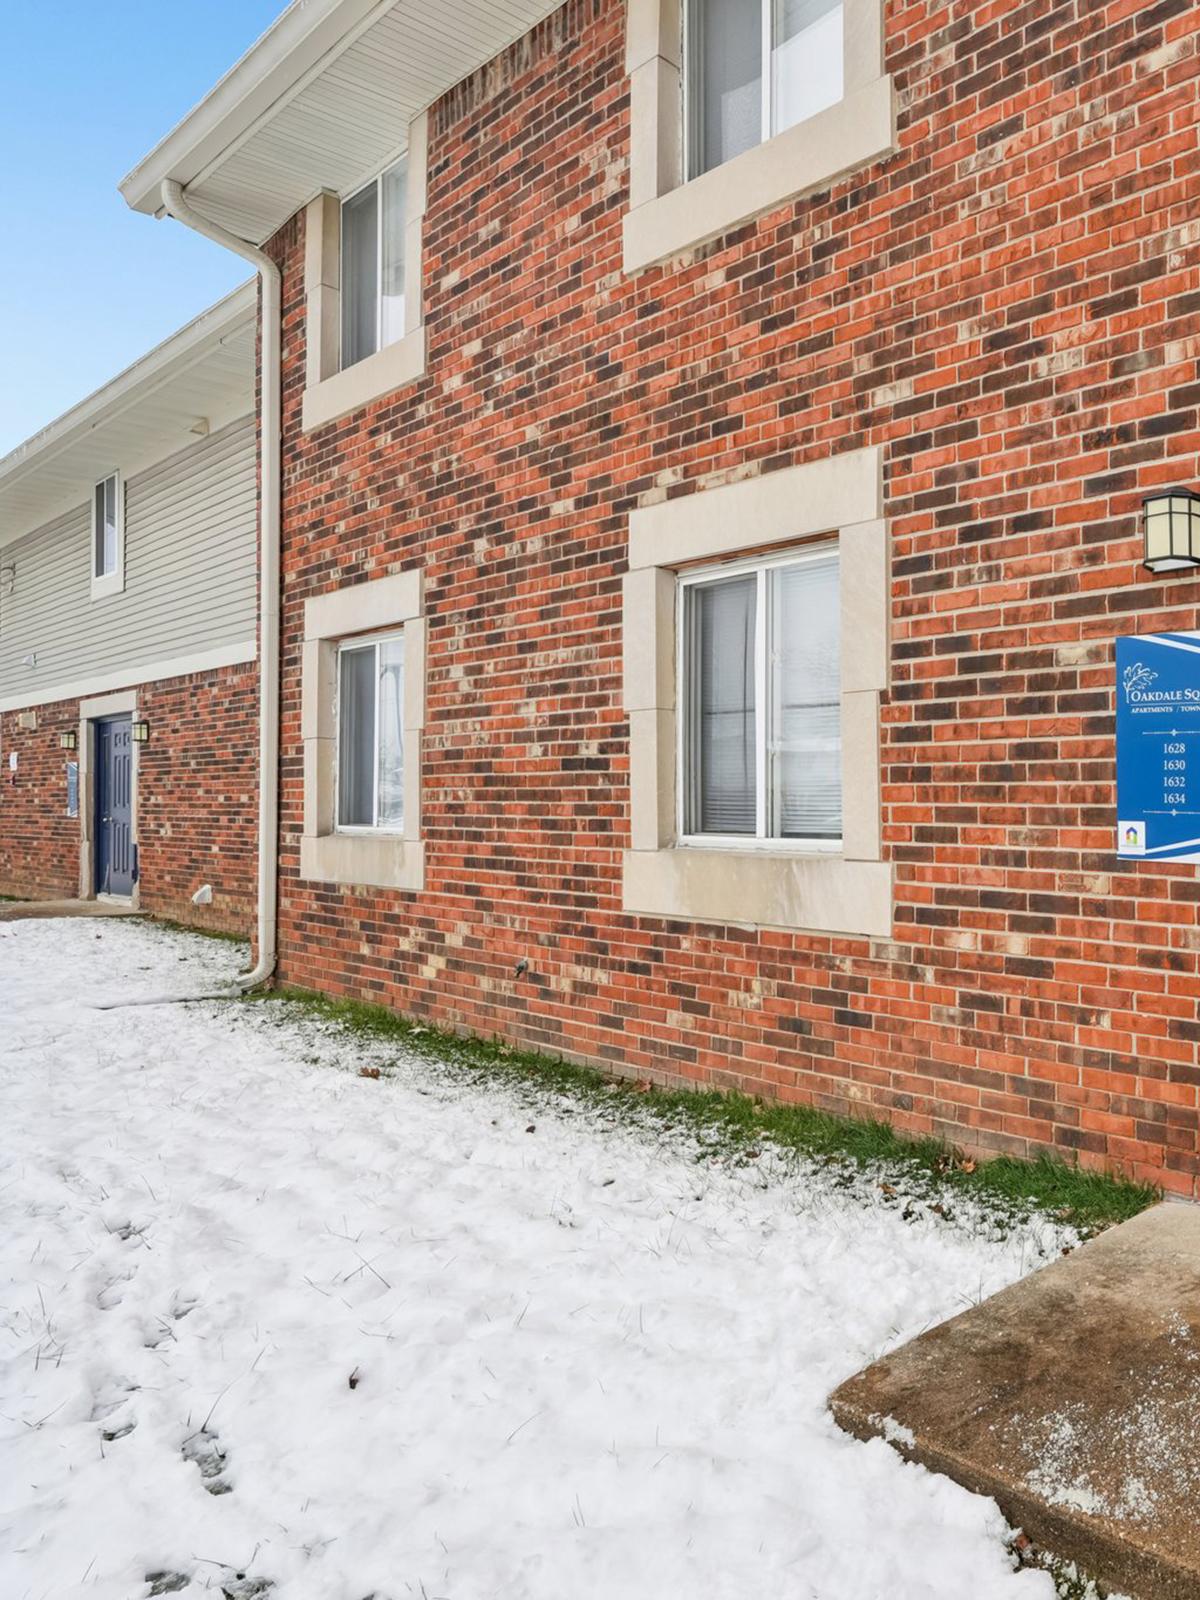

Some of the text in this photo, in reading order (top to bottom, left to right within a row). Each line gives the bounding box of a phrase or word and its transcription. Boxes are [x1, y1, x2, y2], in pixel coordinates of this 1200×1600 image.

[1131, 691, 1182, 702] OAKDALE
[1131, 706, 1173, 714] APARTMENTS
[1163, 743, 1186, 754] 1628
[1163, 760, 1186, 771] 1630
[1163, 776, 1186, 787] 1632
[1163, 793, 1186, 804] 1634
